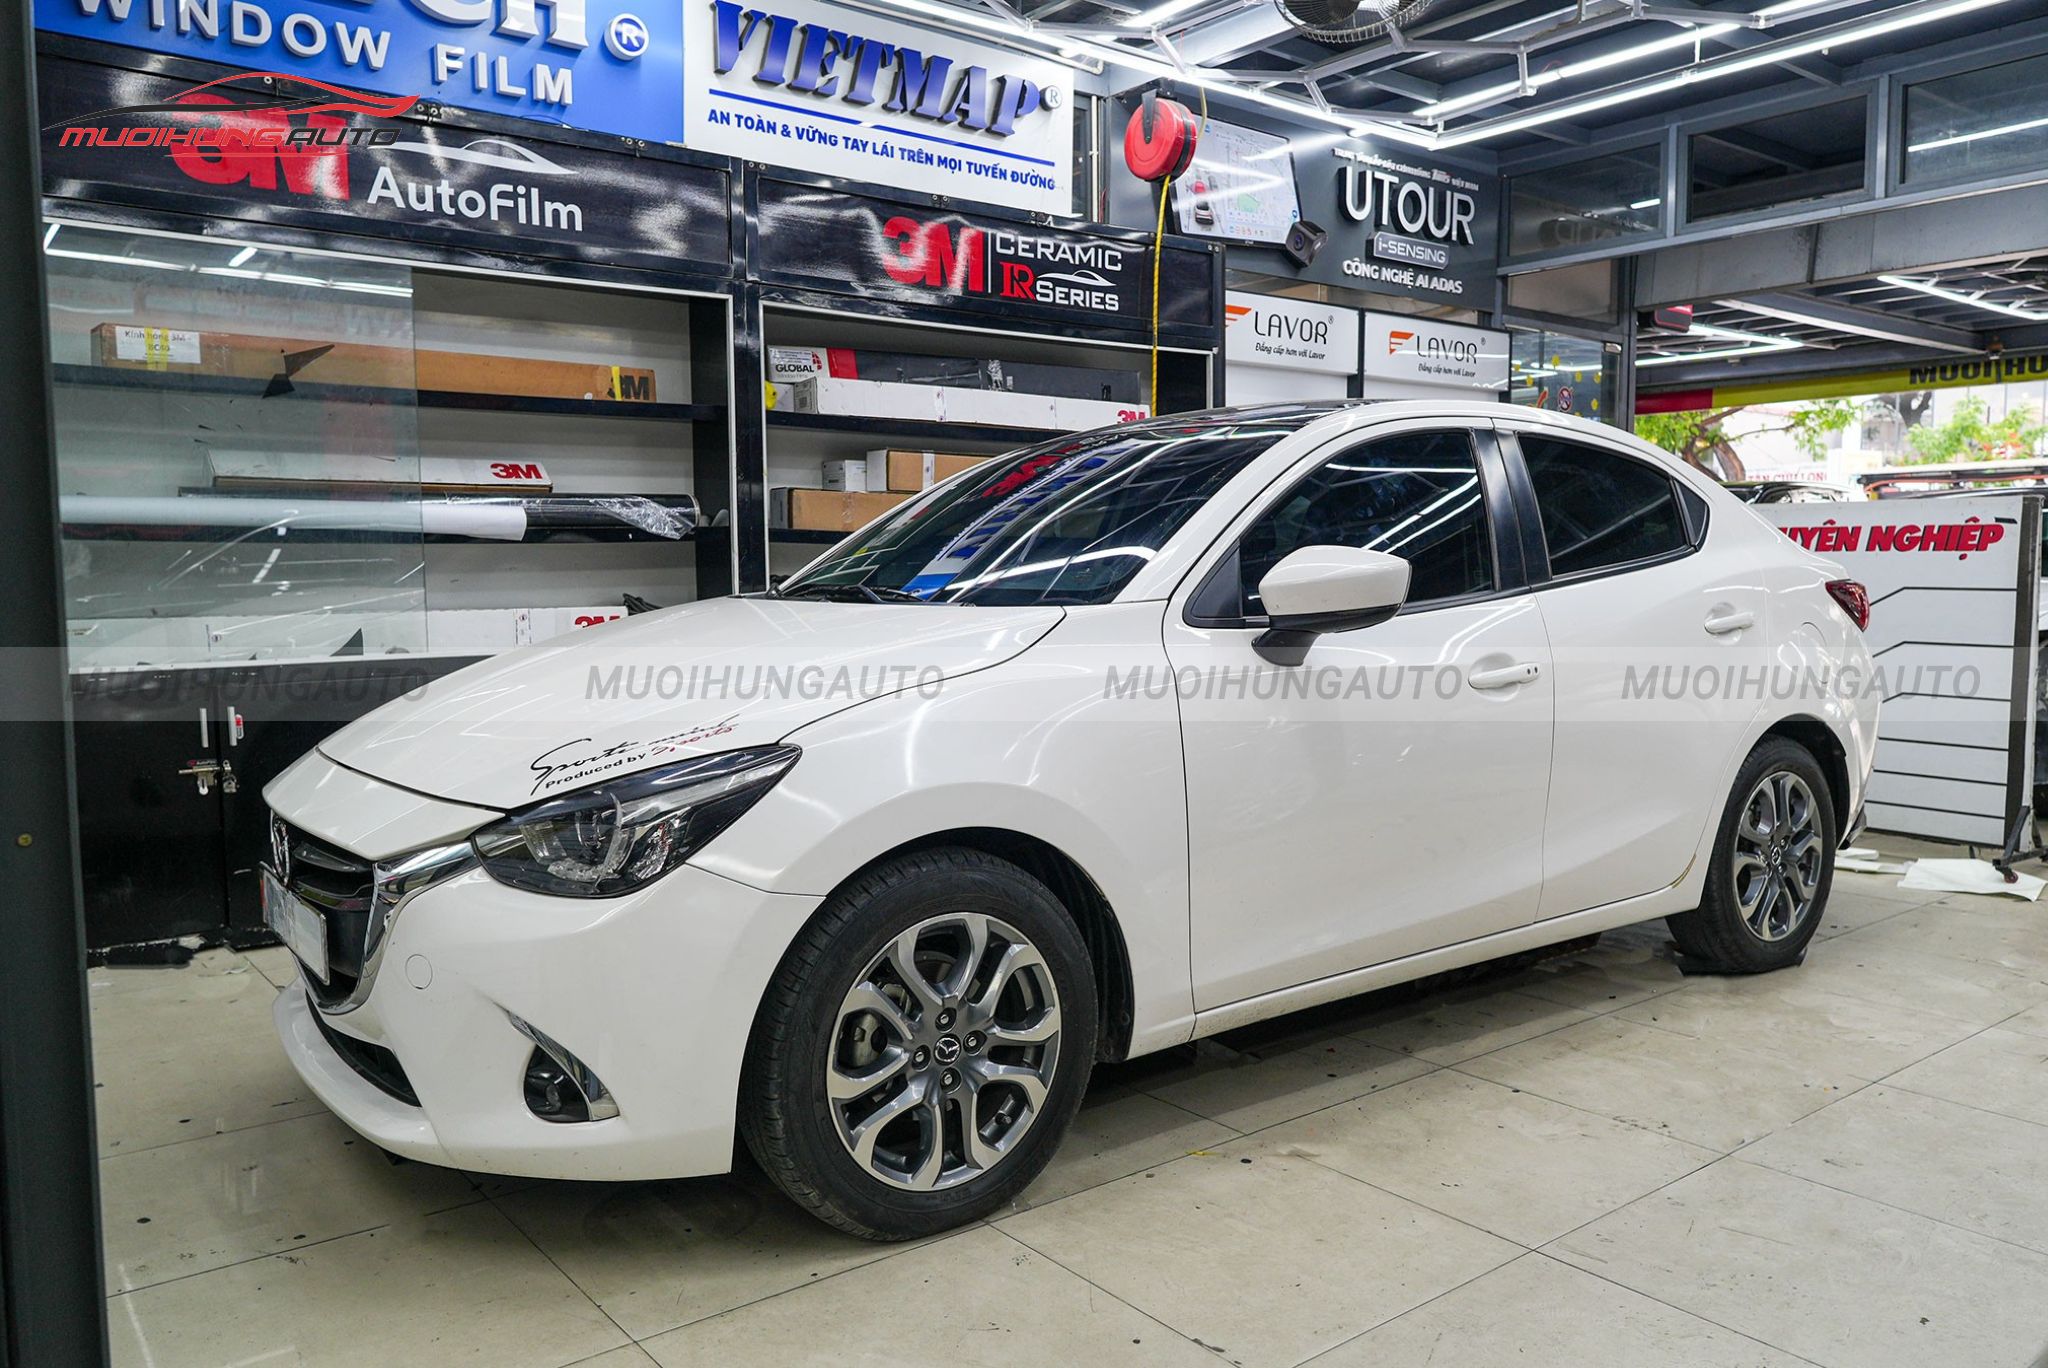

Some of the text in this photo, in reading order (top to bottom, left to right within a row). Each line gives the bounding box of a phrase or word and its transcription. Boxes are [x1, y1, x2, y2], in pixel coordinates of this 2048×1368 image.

[433, 43, 574, 105] FILM
[704, 0, 1042, 137] VIETMAP
[708, 109, 1056, 191] AN TOÀN & VỮNG TAY LÁI TRÊN MỌI TUYẾN ĐƯỜNG
[367, 166, 583, 232] AutoFilm
[1340, 166, 1475, 246] UTOUR
[883, 216, 984, 293] 3M
[996, 232, 1122, 272] CERAMIC
[1378, 238, 1446, 264] i-SENSING
[1343, 257, 1463, 294] CÔNG NGHỆ AI ADAS
[1255, 311, 1328, 345] LAVOR
[775, 363, 815, 373] GLOBAL
[1417, 335, 1477, 365] LAVOR
[490, 463, 543, 479] 3M
[1865, 516, 2005, 561] NGHIỆP
[545, 758, 623, 789] Produced
[626, 752, 646, 765] by
